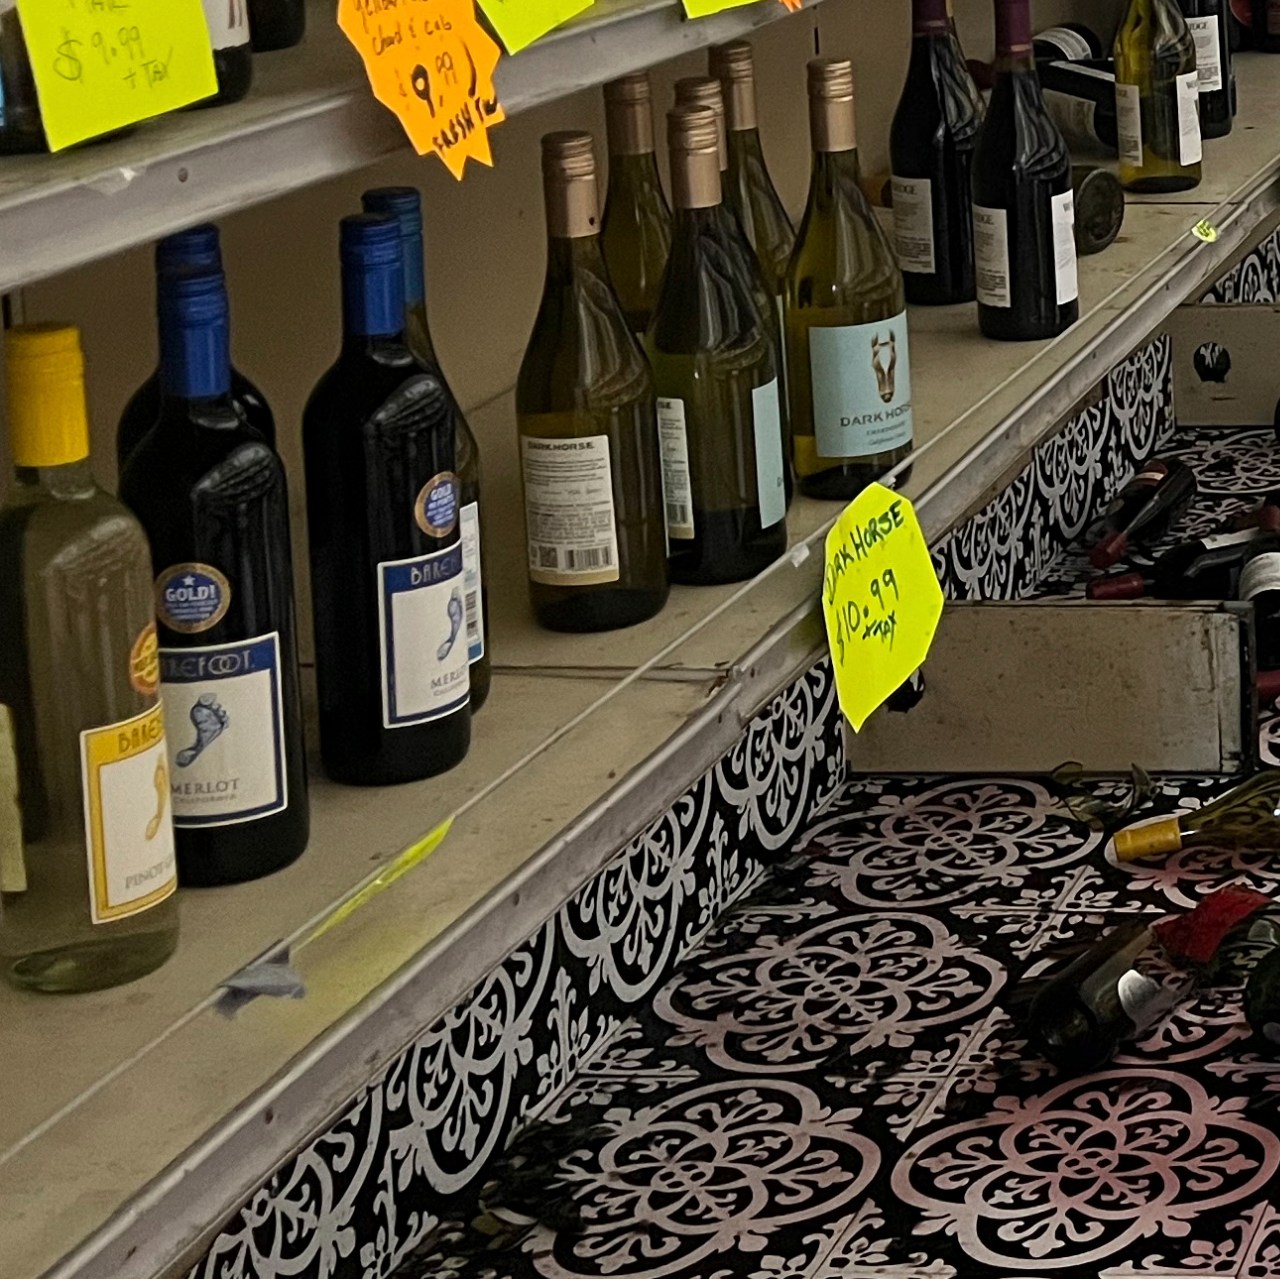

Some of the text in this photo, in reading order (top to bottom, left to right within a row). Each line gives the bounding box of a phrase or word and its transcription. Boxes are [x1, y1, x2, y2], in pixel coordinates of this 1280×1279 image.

[840, 409, 881, 429] DARK
[852, 498, 905, 555] HORSE
[164, 584, 217, 603] GOLD!
